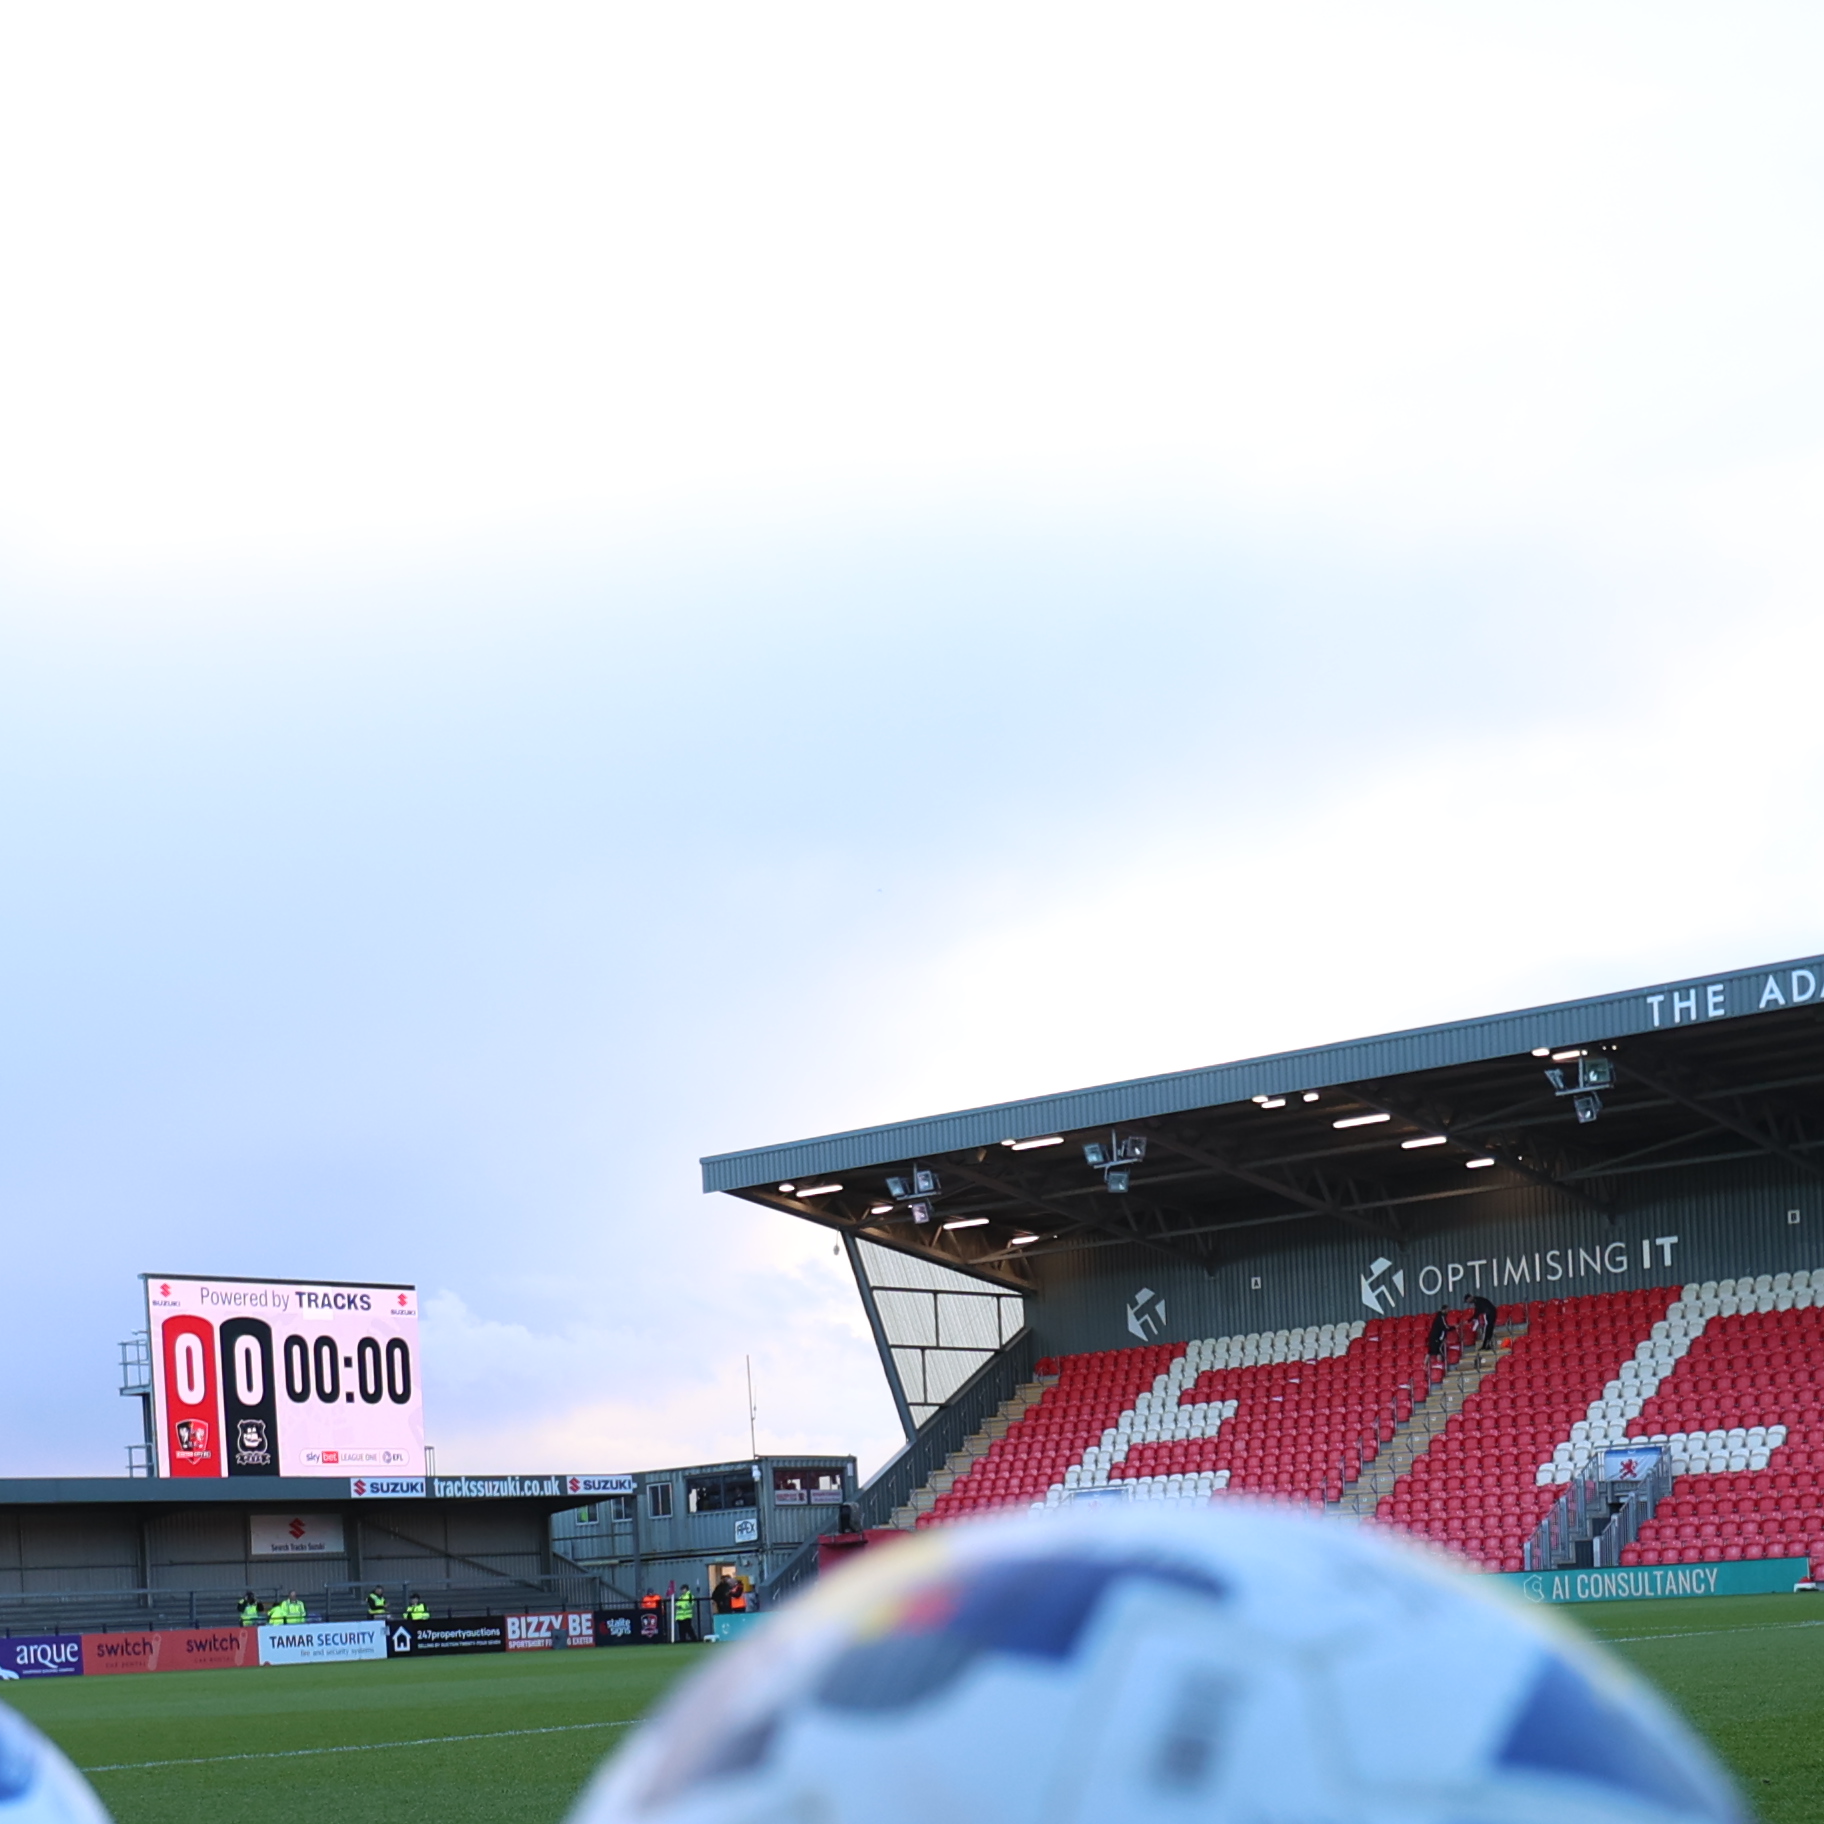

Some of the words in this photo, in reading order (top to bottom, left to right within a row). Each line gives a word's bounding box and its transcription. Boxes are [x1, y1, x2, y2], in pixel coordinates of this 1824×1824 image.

[1646, 984, 1725, 1027] THE
[1418, 1242, 1629, 1295] OPTIMISING
[1642, 1235, 1678, 1269] IT
[200, 1287, 268, 1307] Powered
[272, 1290, 289, 1312] by
[295, 1291, 372, 1311] TRACKS
[174, 1332, 207, 1405] 0
[234, 1334, 264, 1406] 0
[283, 1334, 412, 1405] 00:00
[306, 1452, 320, 1463] sky
[323, 1452, 338, 1462] bet
[340, 1453, 364, 1461] LEAGUE
[365, 1453, 378, 1461] ONE
[392, 1453, 404, 1461] EFL
[369, 1482, 424, 1493] SUZUKI
[434, 1476, 561, 1497] trackssuzuki.co.uk
[583, 1479, 632, 1491] SUZUKI
[1552, 1575, 1570, 1600] AI
[1577, 1567, 1718, 1598] CONSULTANCY
[417, 1627, 501, 1640] 247propertyauctions
[506, 1614, 563, 1639] BIZZY
[567, 1613, 593, 1636] BE
[97, 1637, 154, 1658] switch
[186, 1633, 240, 1654] switch
[269, 1634, 314, 1649] TAMAR
[317, 1631, 375, 1646] SECURITY
[312, 1648, 325, 1656] and
[326, 1648, 350, 1657] security
[351, 1646, 375, 1656] systems
